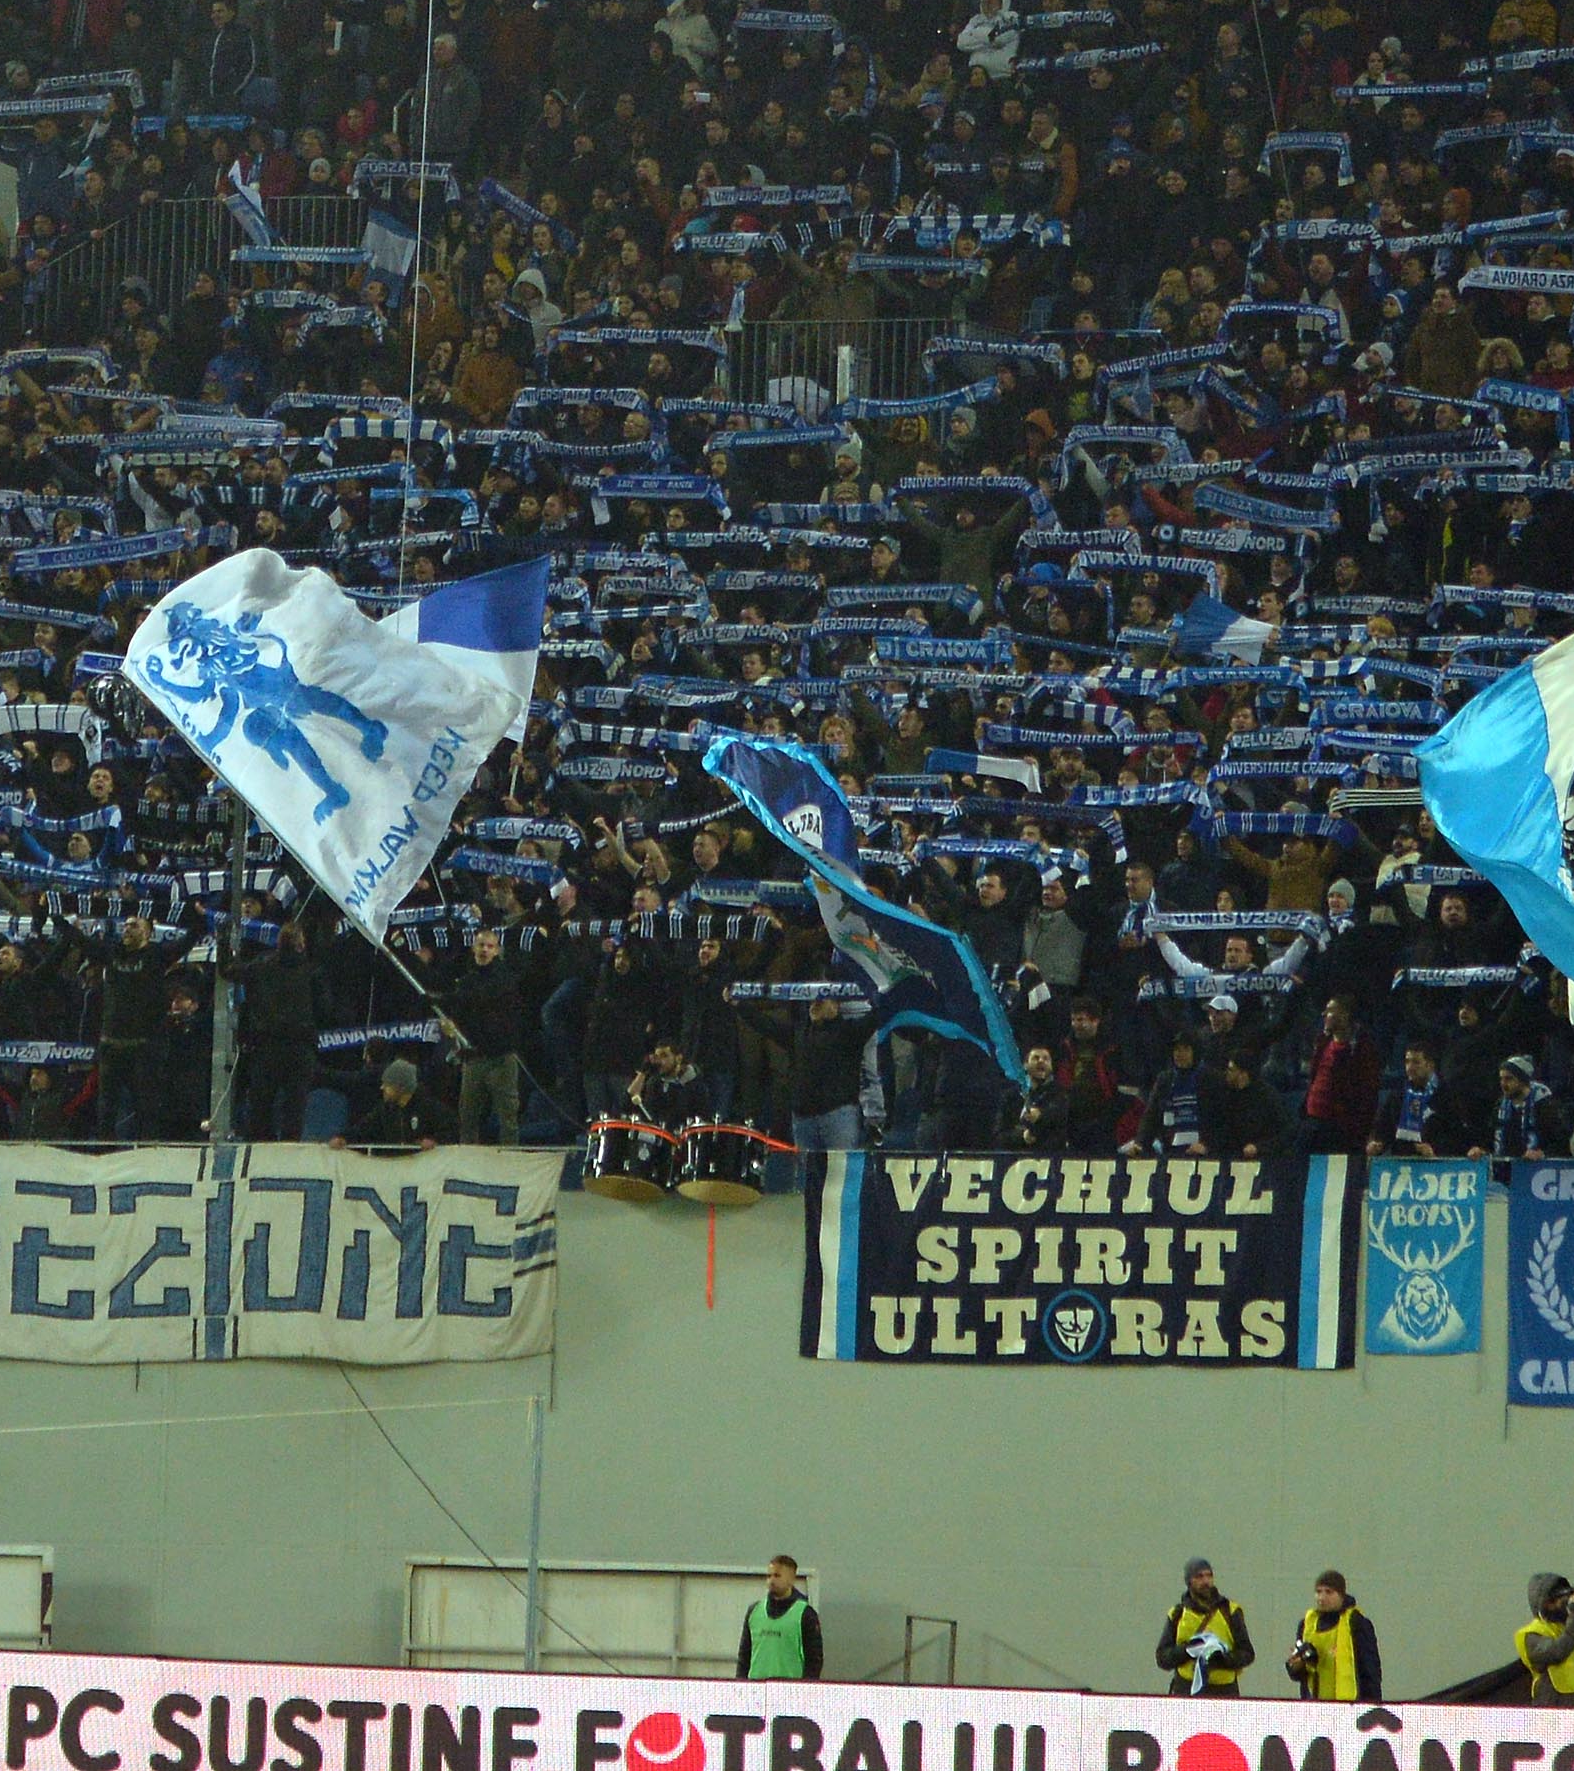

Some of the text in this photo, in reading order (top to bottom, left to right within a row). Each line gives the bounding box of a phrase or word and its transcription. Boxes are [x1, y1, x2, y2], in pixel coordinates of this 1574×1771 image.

[1180, 528, 1286, 552] PELUZA NORD
[906, 640, 987, 660] CRAIOVA
[1333, 701, 1422, 720] CRAIOVA
[620, 761, 666, 780] NORD
[495, 822, 517, 838] LA
[731, 983, 763, 999] ASA
[48, 1044, 95, 1060] NORD
[885, 1157, 1274, 1216] VECHIUL
[1390, 1202, 1456, 1228] BOYS
[915, 1226, 1239, 1287] SPIRIT
